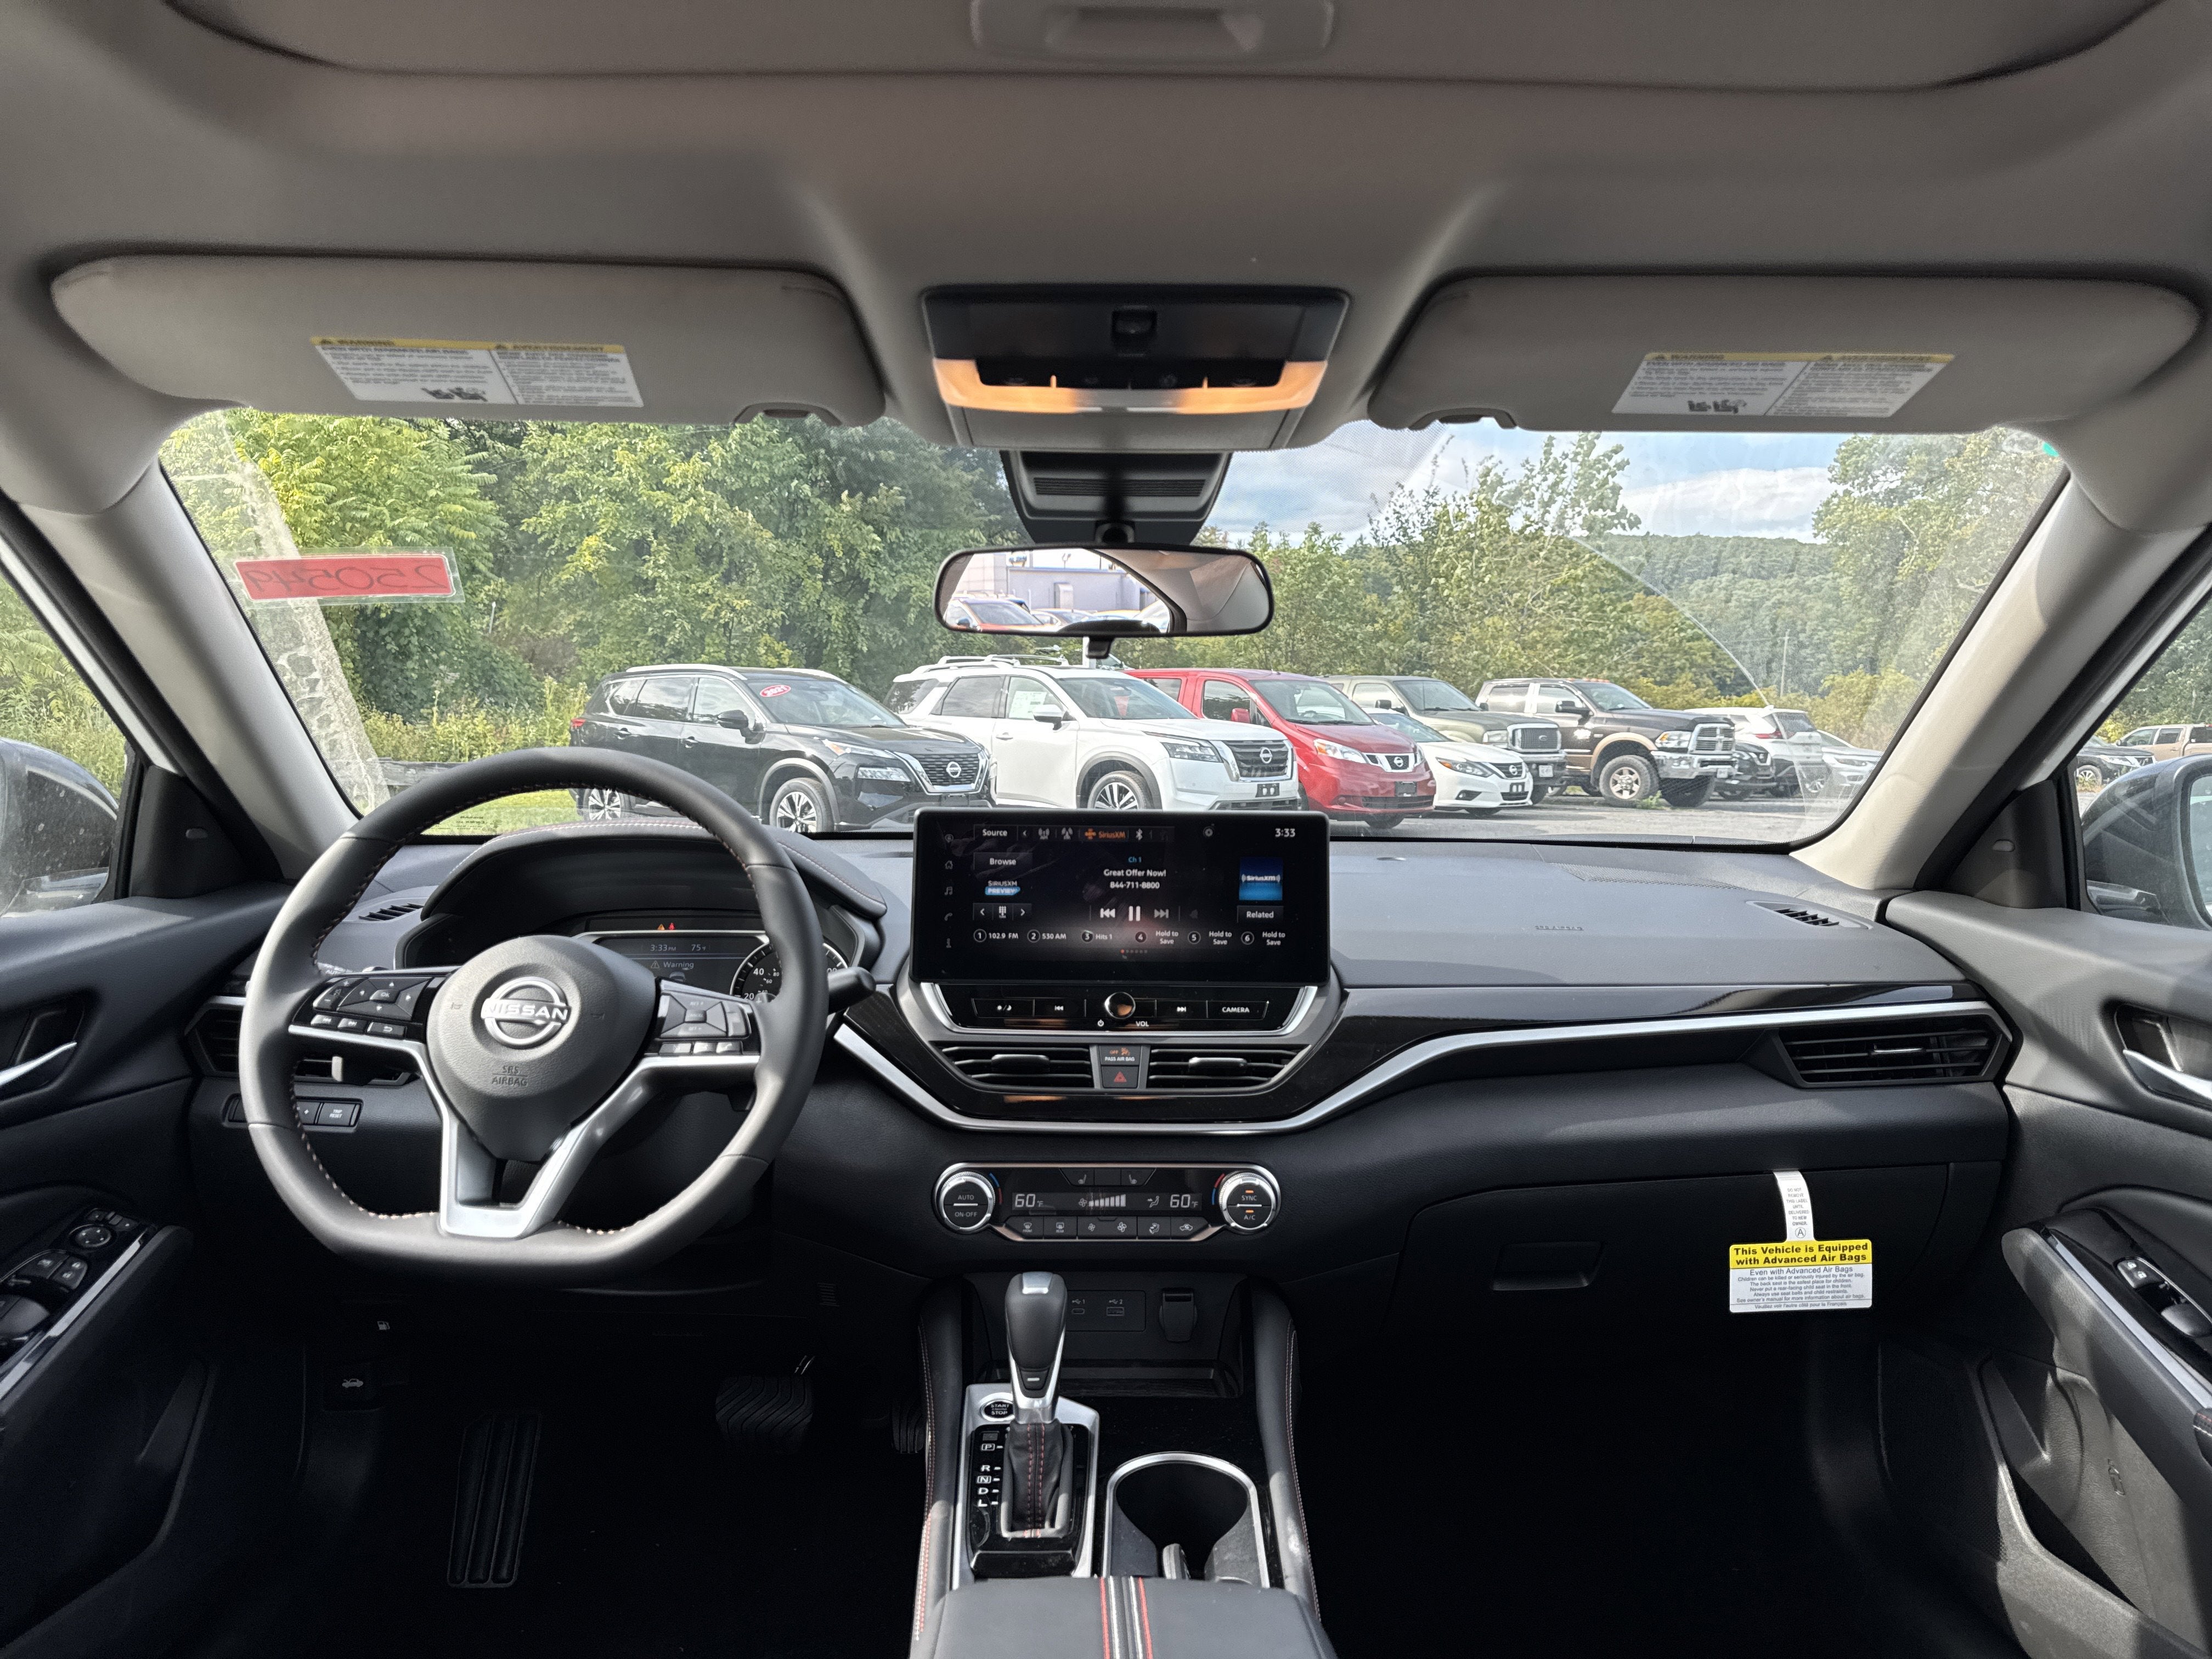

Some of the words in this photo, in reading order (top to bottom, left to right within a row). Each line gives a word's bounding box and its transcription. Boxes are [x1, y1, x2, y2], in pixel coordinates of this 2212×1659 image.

[982, 828, 1008, 837] Source
[1275, 828, 1296, 837] 3:33
[1125, 868, 1145, 877] Offer
[486, 1002, 568, 1021] NISSAN
[502, 1065, 520, 1074] SRS
[492, 1076, 528, 1087] AIRBAG
[1734, 1247, 1757, 1255] This
[1761, 1245, 1801, 1254] Vehicle
[1805, 1244, 1814, 1252] is
[1818, 1243, 1868, 1254] Equipped
[1736, 1257, 1759, 1265] with
[1763, 1254, 1816, 1265] Advanced
[1820, 1254, 1836, 1262] Air
[1839, 1254, 1866, 1262] Bags
[978, 1499, 988, 1507] L
